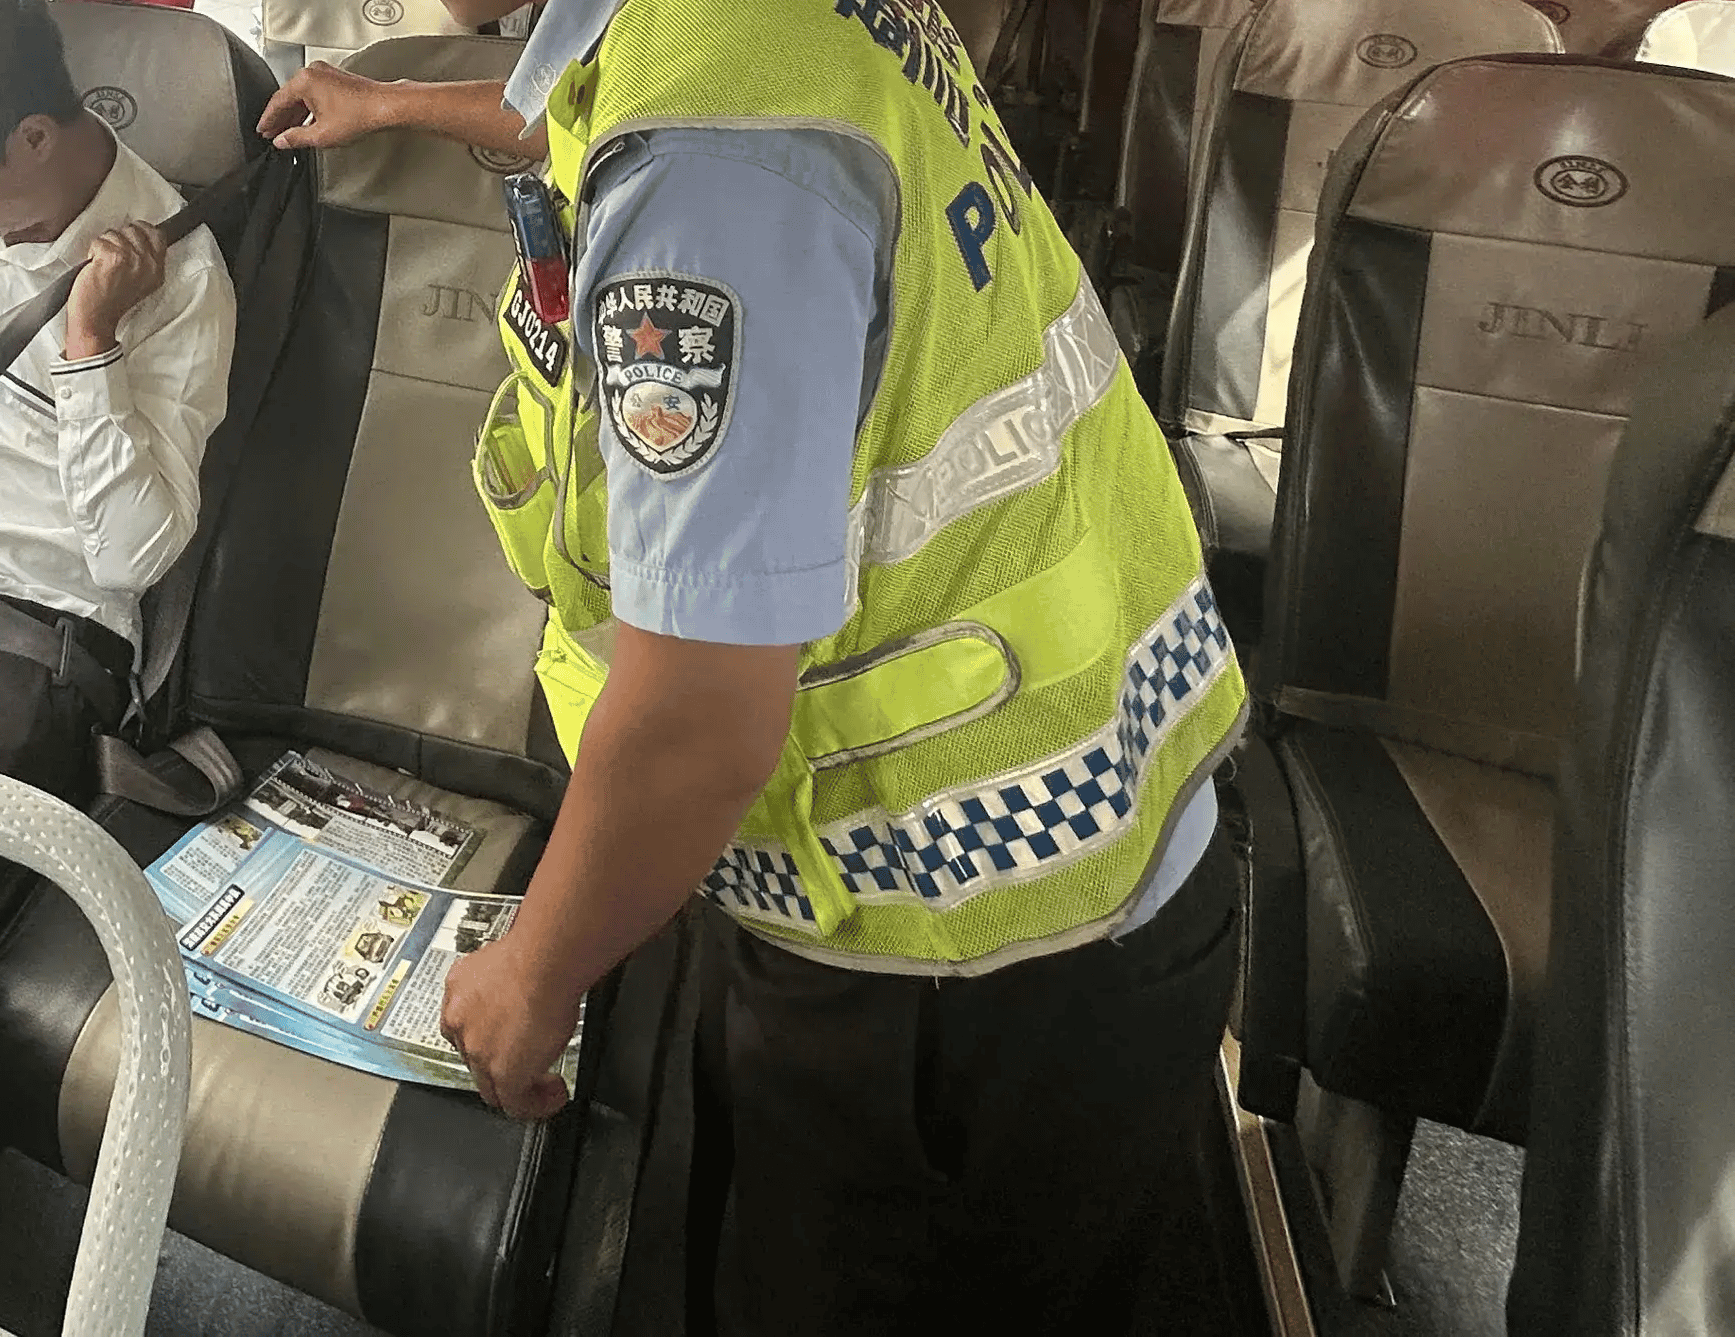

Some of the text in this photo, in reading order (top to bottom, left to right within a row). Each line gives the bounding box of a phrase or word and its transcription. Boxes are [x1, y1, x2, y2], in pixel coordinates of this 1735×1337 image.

[420, 283, 499, 325] JIN
[597, 284, 731, 327] 中华人民共和国
[511, 289, 559, 372] GJ0214
[602, 324, 716, 364] 警 察
[623, 364, 683, 384] POLICE
